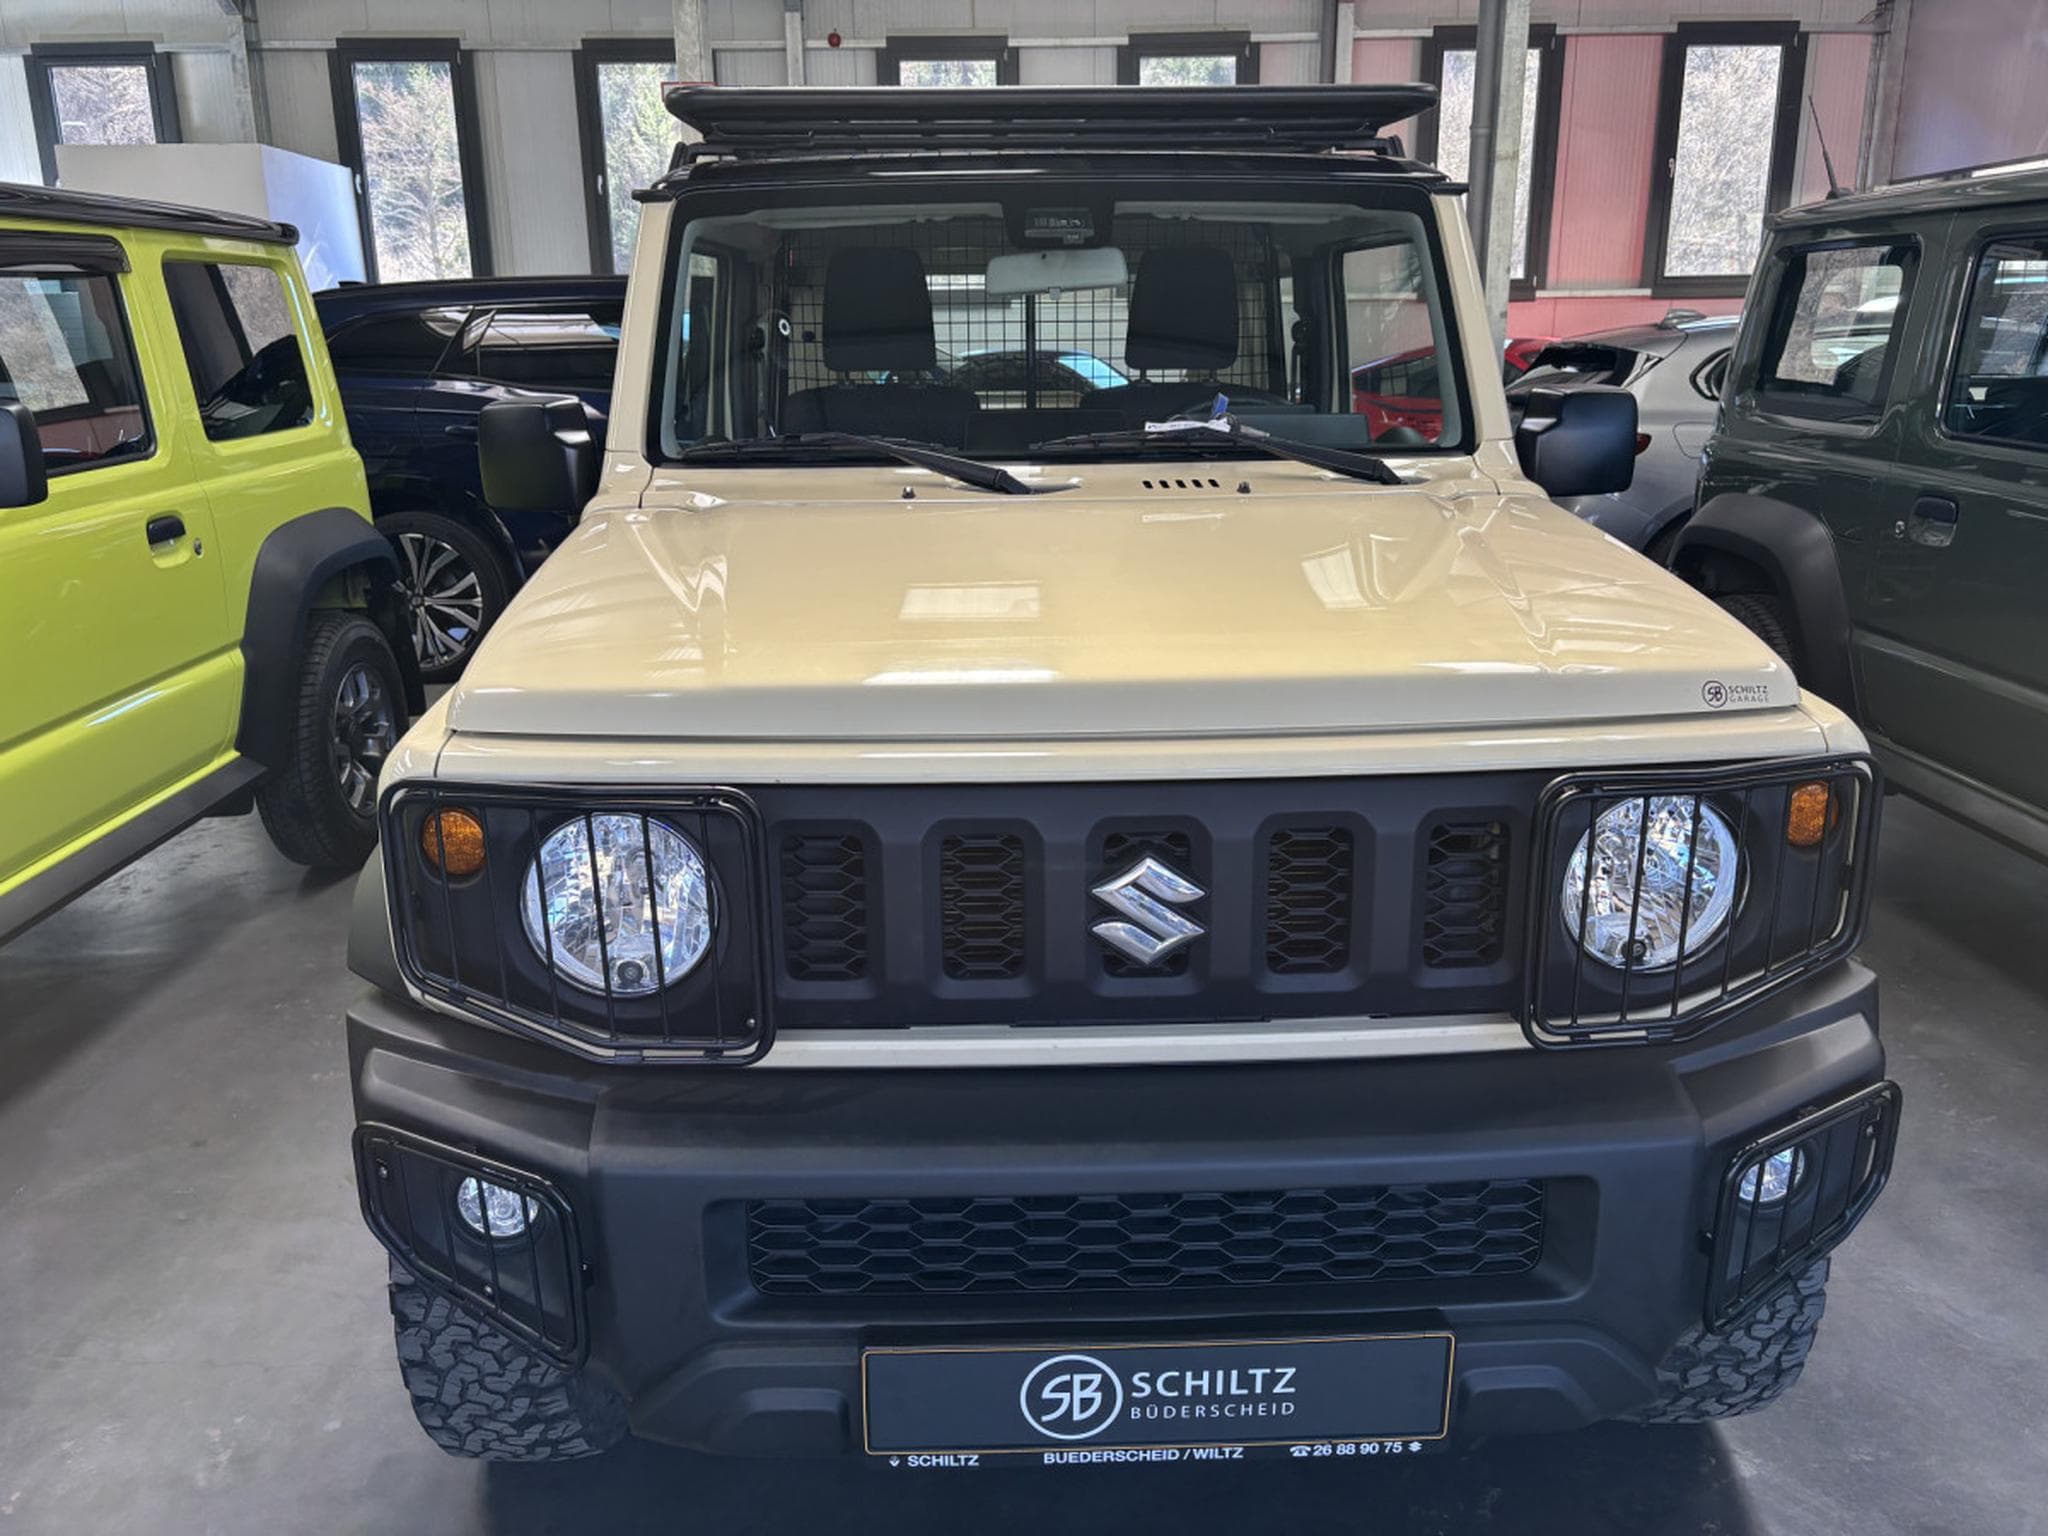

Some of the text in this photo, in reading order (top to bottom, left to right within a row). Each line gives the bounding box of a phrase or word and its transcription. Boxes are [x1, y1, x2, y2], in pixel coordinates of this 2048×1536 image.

[1728, 685, 1768, 694] SCHILTZ
[1729, 695, 1770, 703] GARAGE
[1131, 1367, 1297, 1398] SCHILTZ
[1041, 1373, 1102, 1422] SB
[1130, 1402, 1296, 1420] BÜDERSCHEID
[1312, 1441, 1403, 1456] 26 88 90 75
[907, 1454, 980, 1467] SCHILTZ
[1043, 1449, 1180, 1464] BUEDERSCHEID
